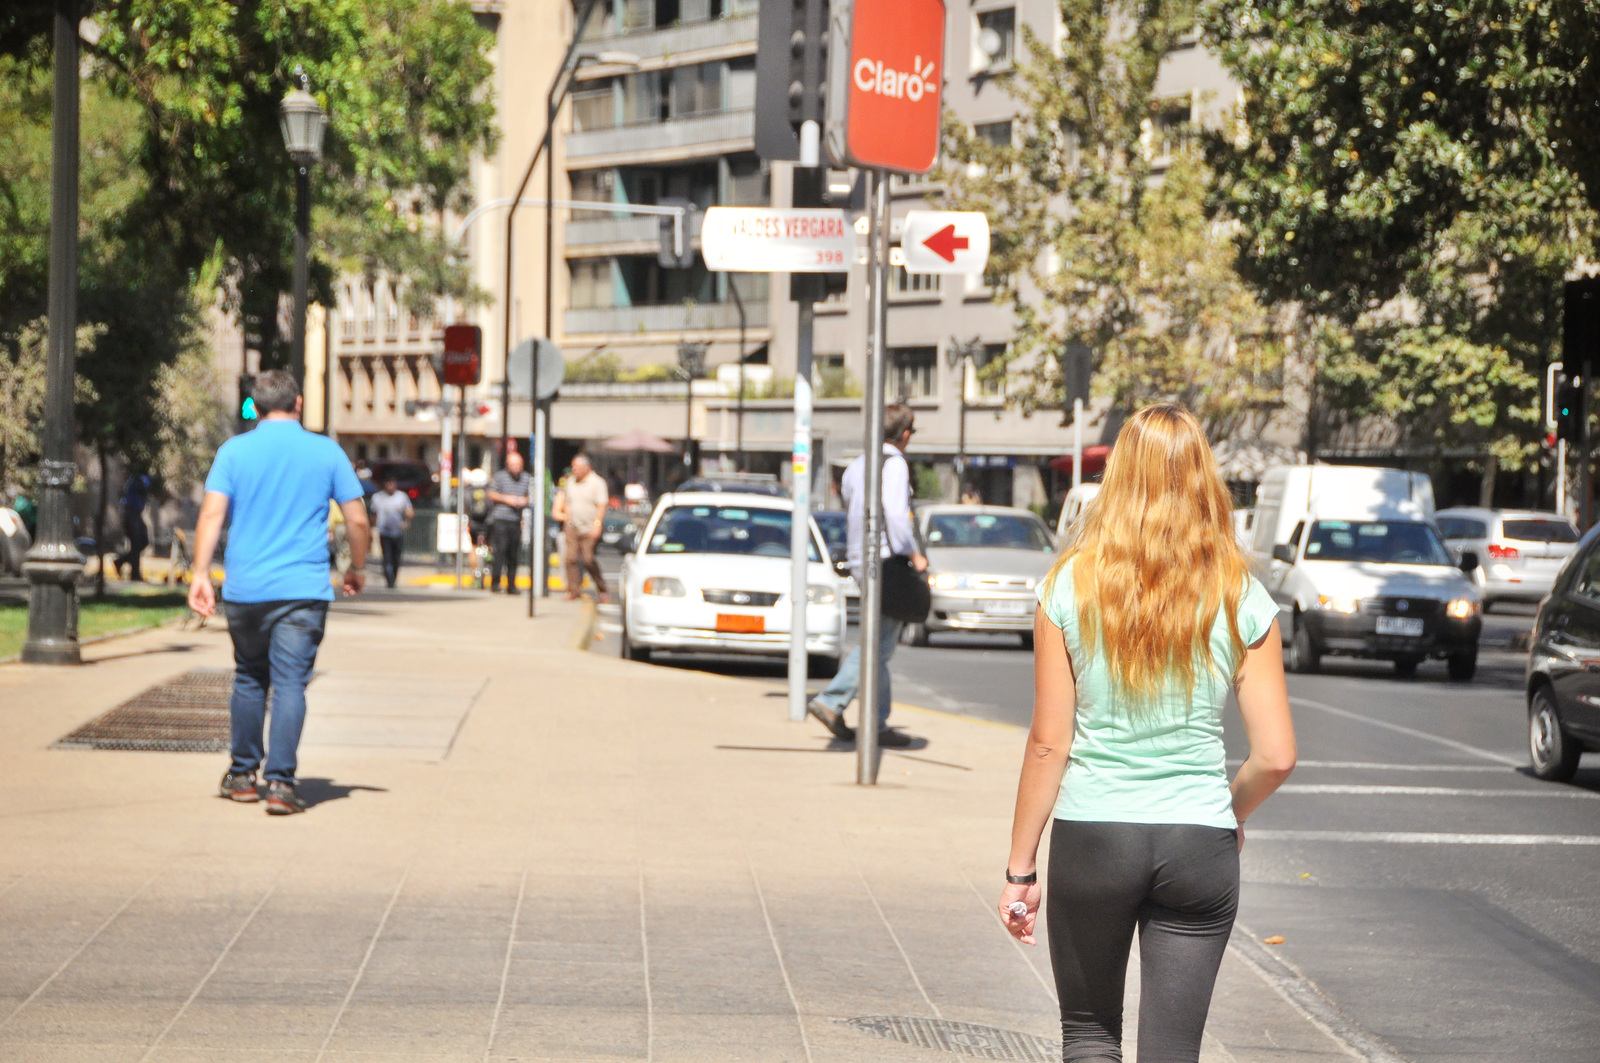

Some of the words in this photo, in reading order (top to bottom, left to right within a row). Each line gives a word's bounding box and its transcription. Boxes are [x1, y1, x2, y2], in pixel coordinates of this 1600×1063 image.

[854, 57, 925, 102] Claro
[732, 216, 780, 238] ADES
[784, 216, 844, 239] VERGARA
